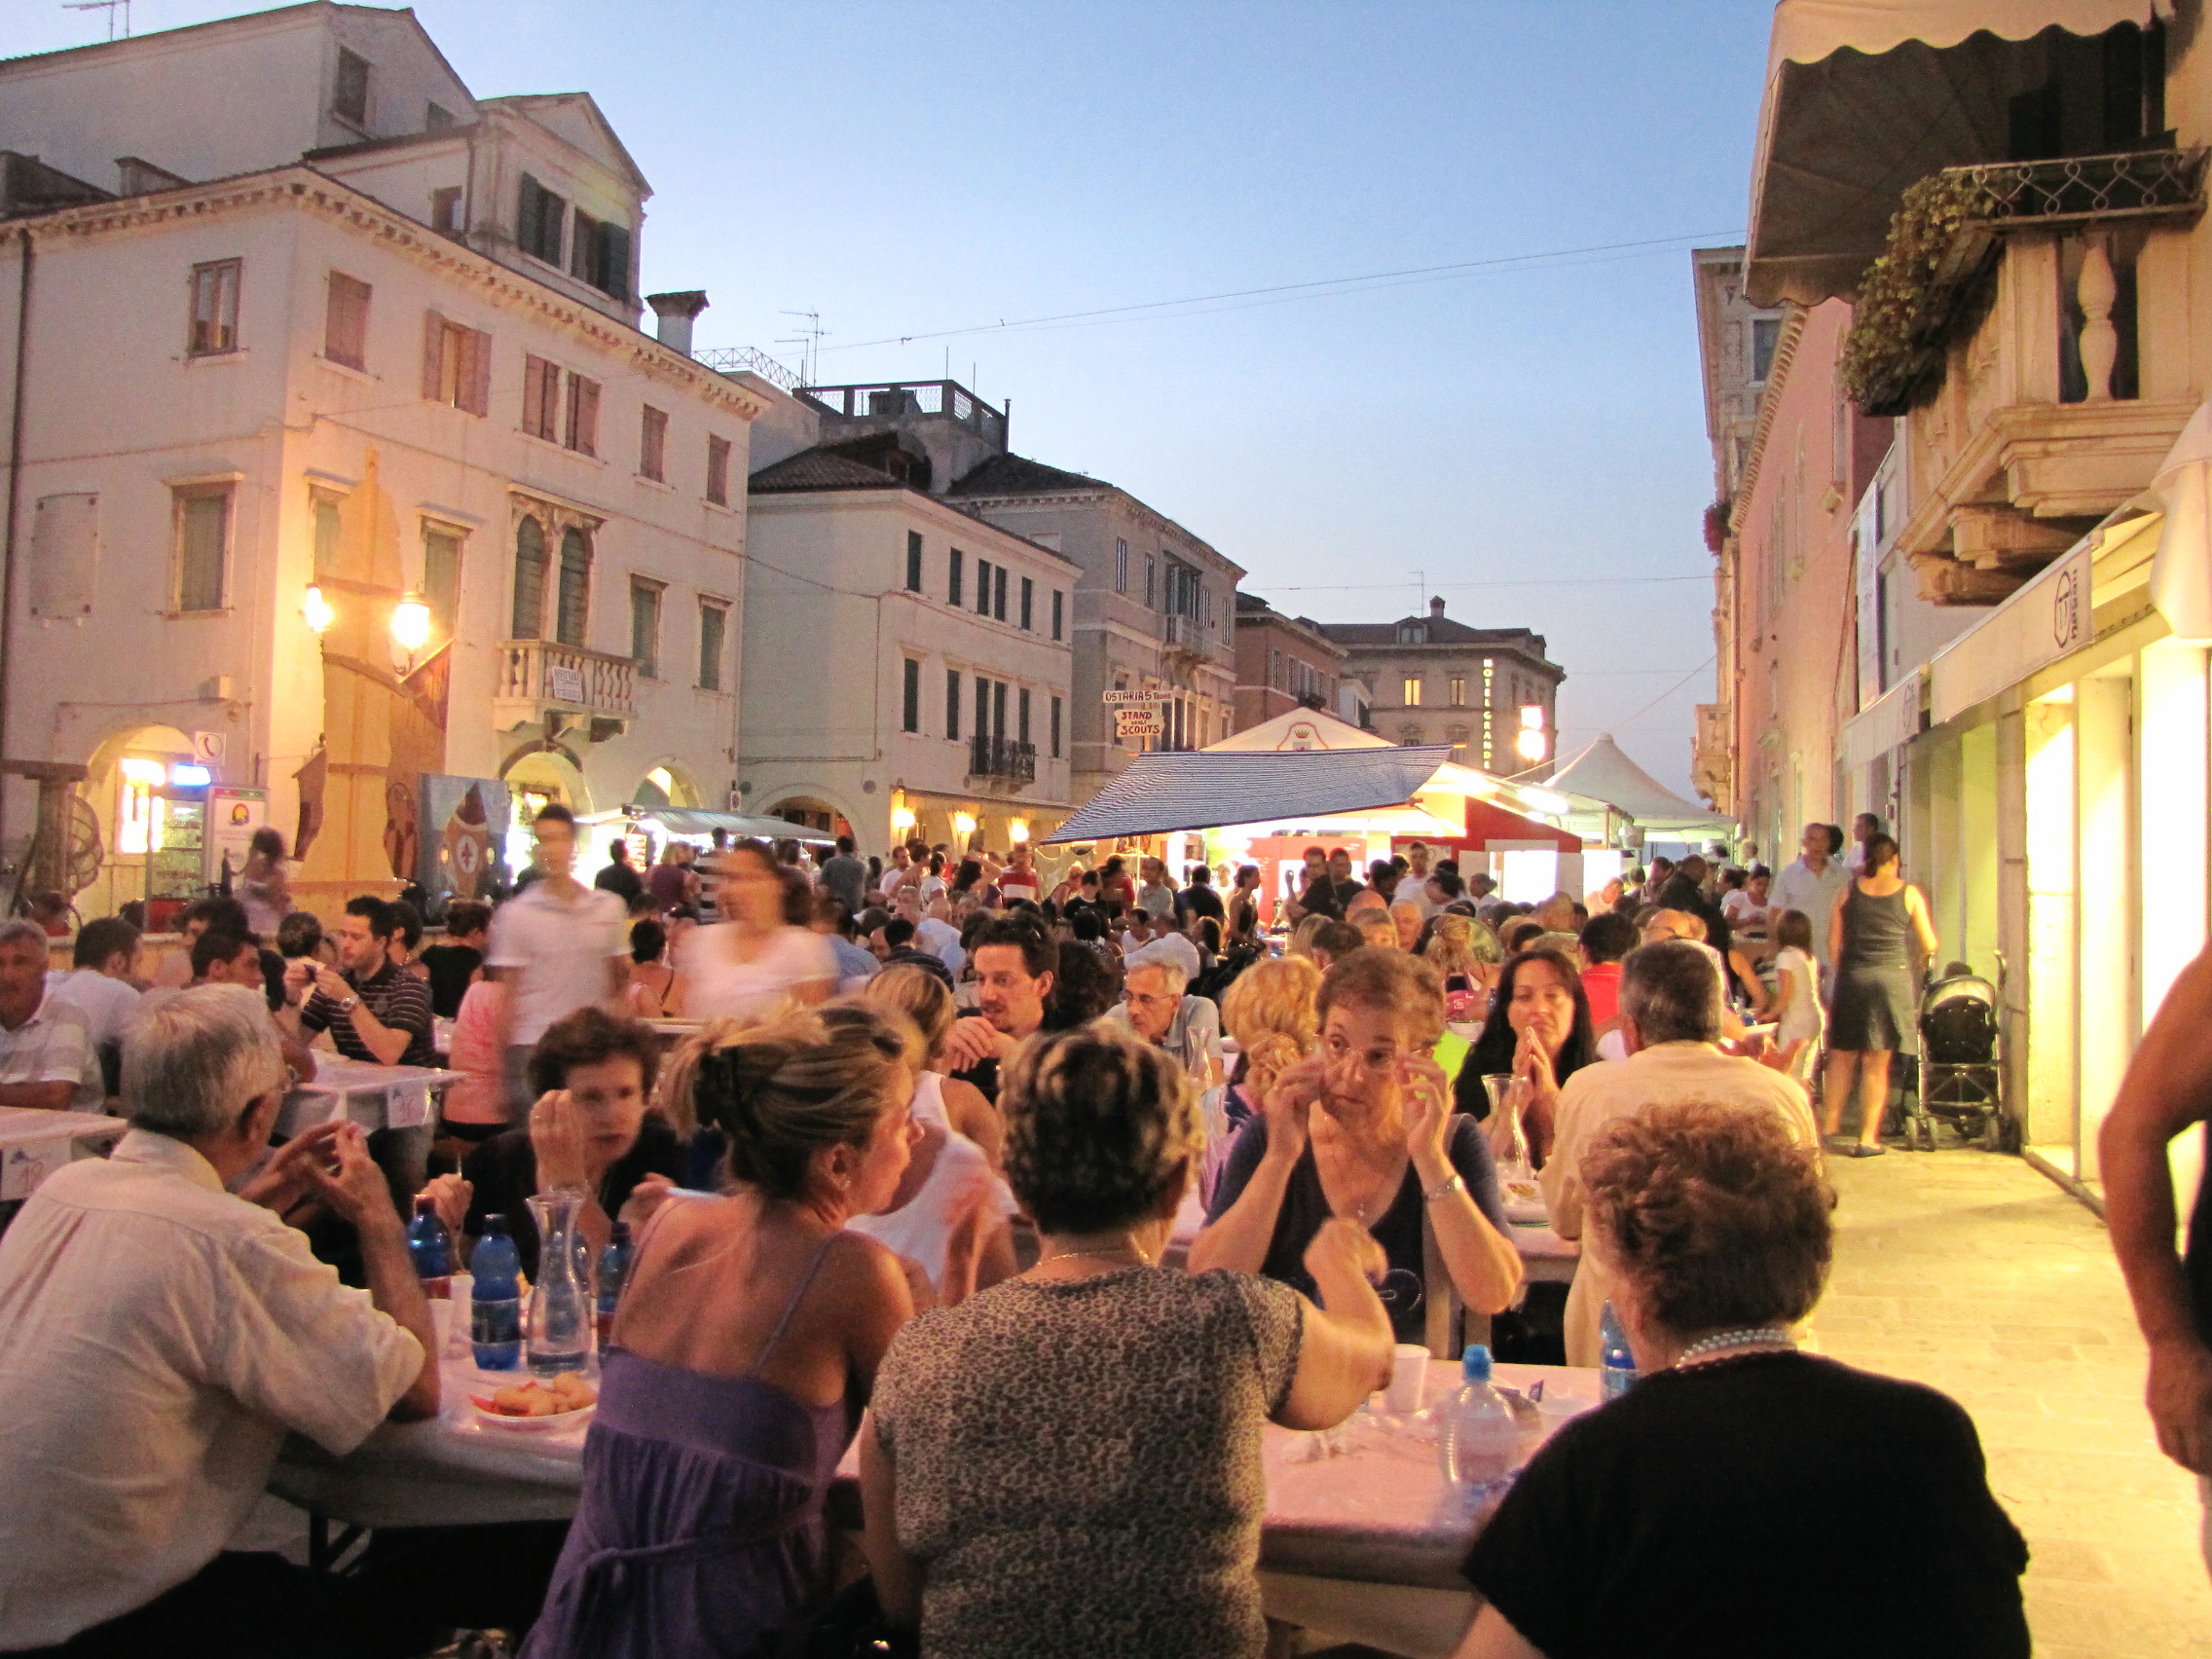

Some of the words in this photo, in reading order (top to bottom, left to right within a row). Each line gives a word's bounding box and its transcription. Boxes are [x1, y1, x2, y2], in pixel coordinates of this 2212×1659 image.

[1105, 690, 1144, 702] OSTARIA
[1121, 711, 1153, 720] STAND
[1120, 724, 1161, 736] SCOUTS
[1483, 711, 1493, 769] GRANDE
